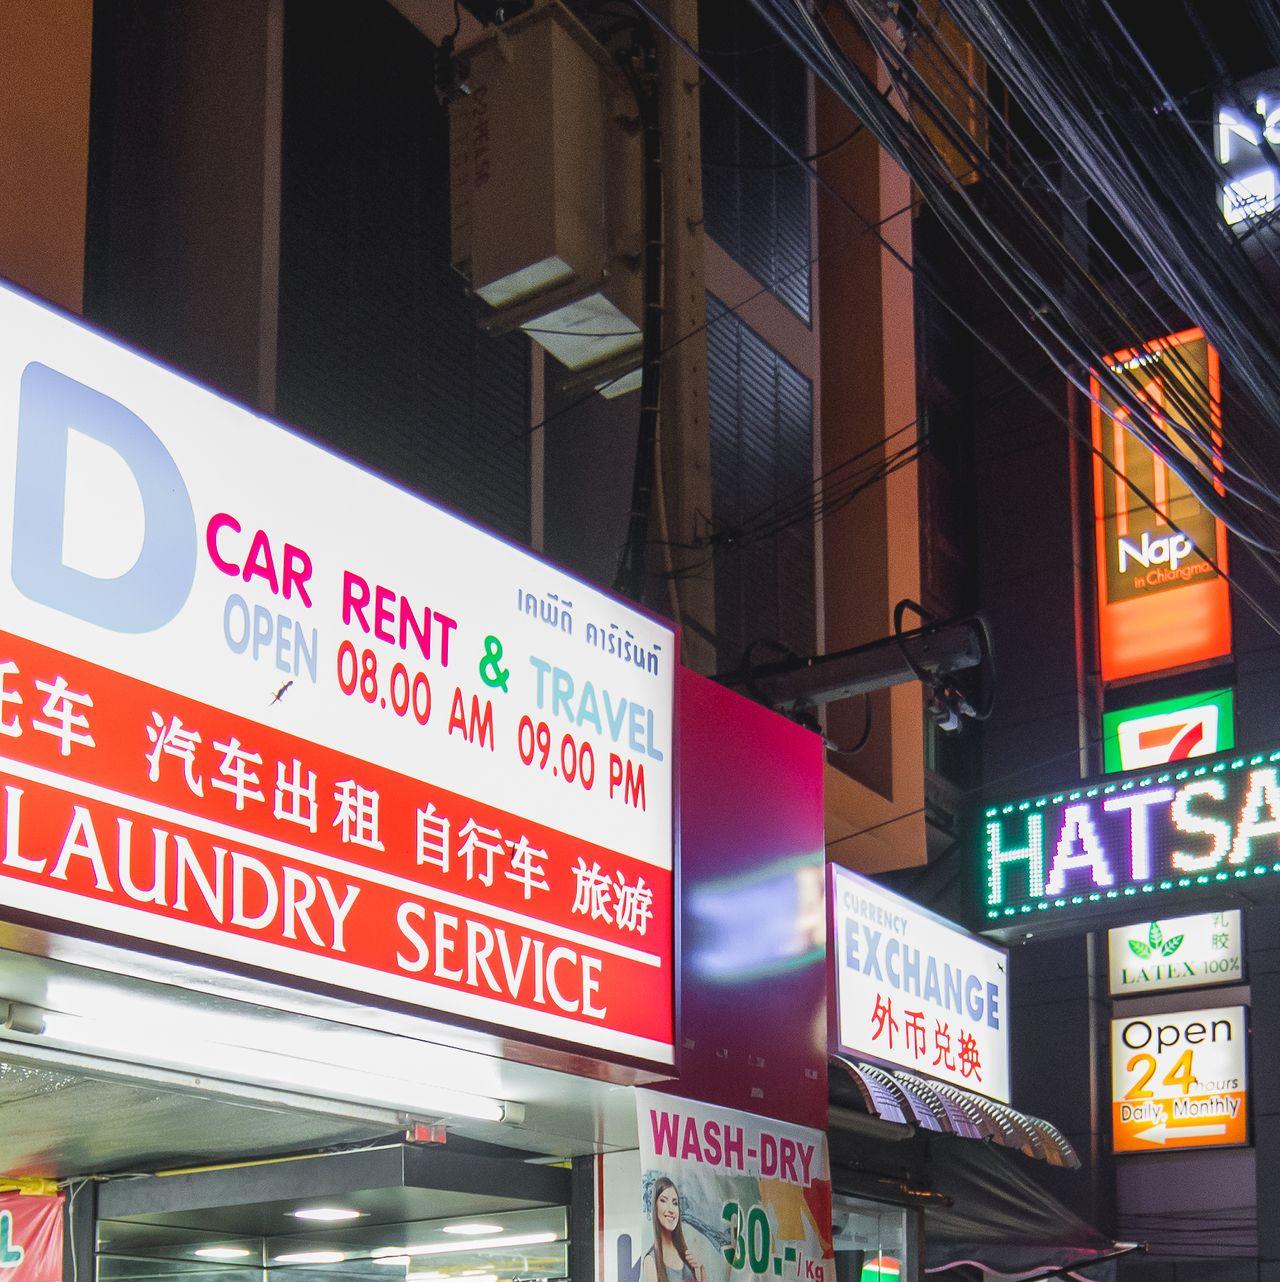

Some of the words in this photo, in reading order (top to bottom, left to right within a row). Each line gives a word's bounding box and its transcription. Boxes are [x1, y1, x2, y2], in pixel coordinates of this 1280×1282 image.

[1118, 533, 1192, 574] Nap
[207, 513, 312, 608] CAR
[343, 570, 458, 667] RENT
[480, 636, 510, 693] &
[530, 656, 663, 761] TRAVEL
[223, 593, 318, 683] OPEN
[337, 640, 432, 726] 08.00
[448, 687, 495, 752] AM
[518, 715, 595, 791] 09.00
[610, 753, 647, 812] PM
[146, 711, 385, 853] 汽车出租
[416, 804, 550, 900] 自行车
[572, 857, 655, 937] 旅游
[2, 785, 360, 953] LAUNDRY
[396, 901, 607, 1020] SERVICE
[843, 891, 908, 937] CURRENCY
[844, 918, 1000, 1031] EXCHANGE
[1121, 963, 1196, 985] LATEX
[1203, 957, 1240, 974] 100%
[871, 993, 982, 1083] 外币兑换
[1122, 1019, 1232, 1054] Open
[1124, 1050, 1197, 1101] 24
[650, 1108, 816, 1188] WASH-DRY
[1174, 1097, 1239, 1119] Monthly
